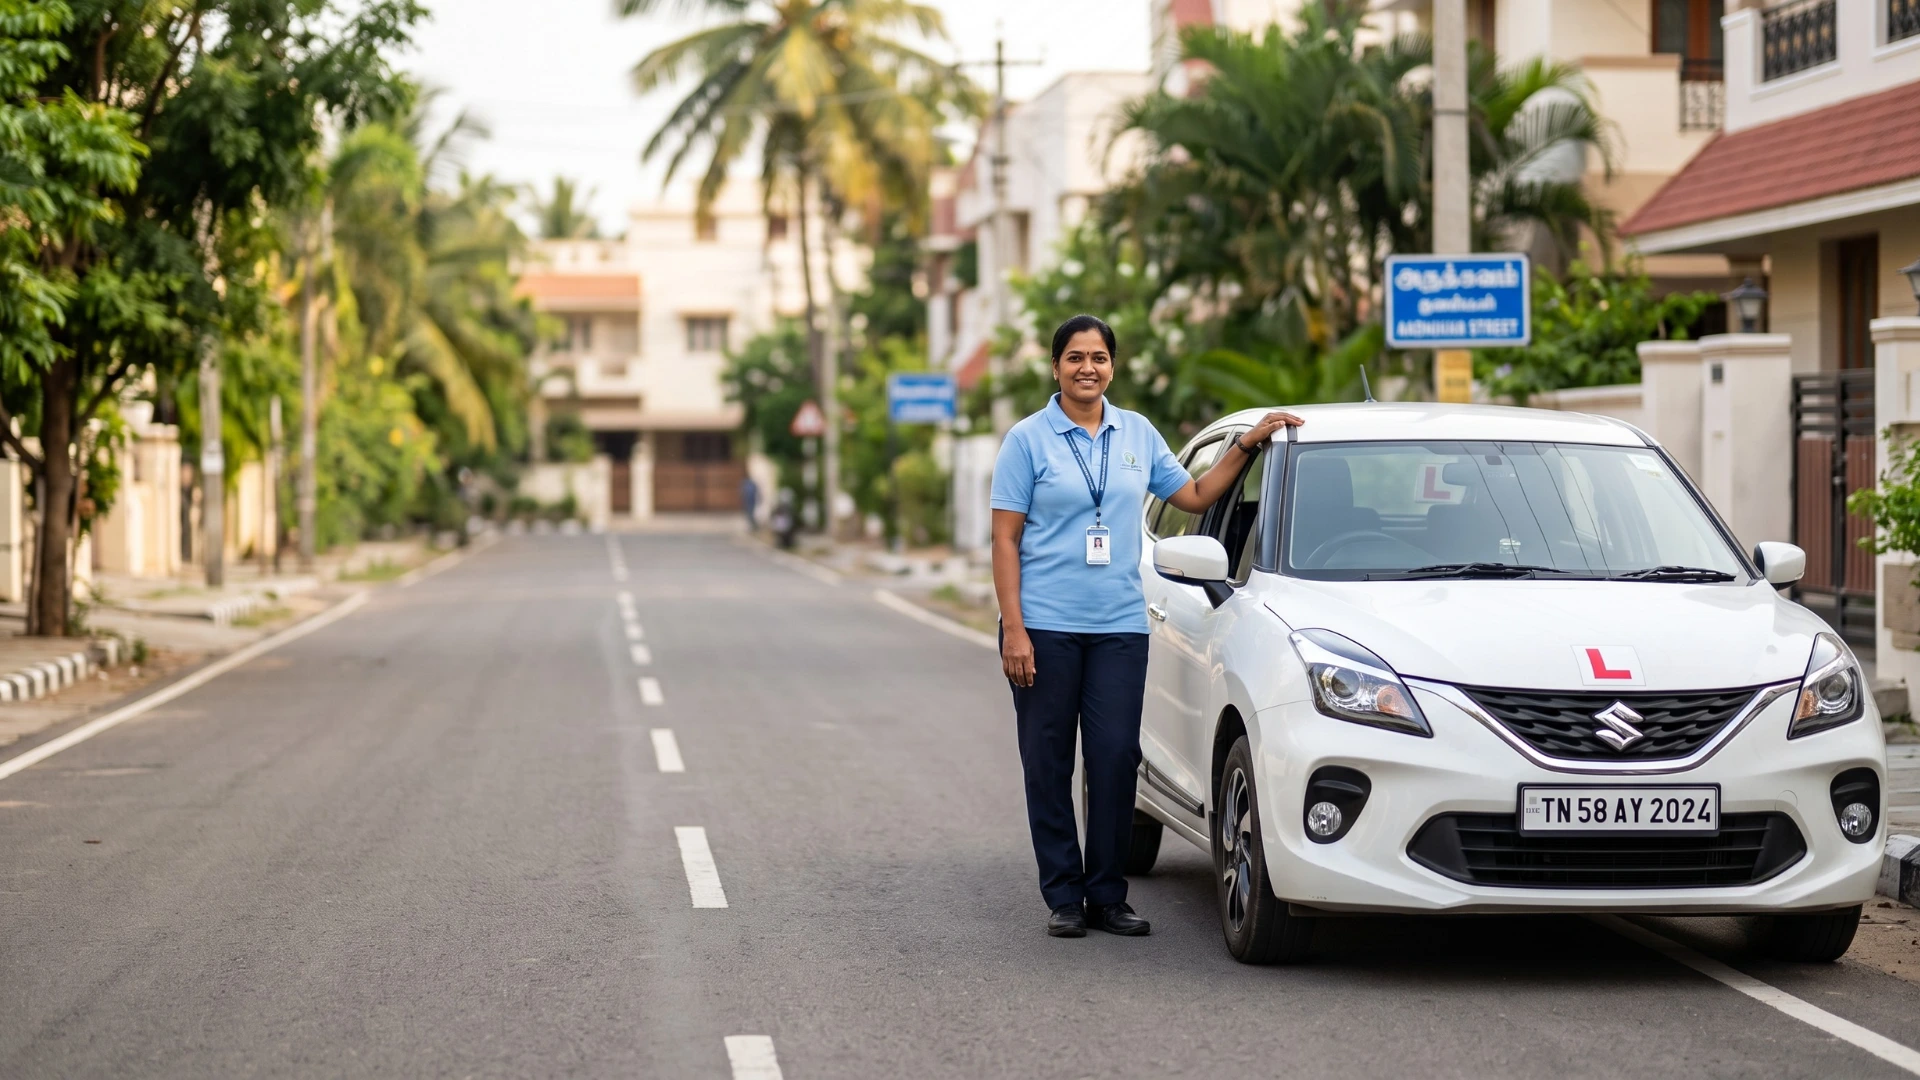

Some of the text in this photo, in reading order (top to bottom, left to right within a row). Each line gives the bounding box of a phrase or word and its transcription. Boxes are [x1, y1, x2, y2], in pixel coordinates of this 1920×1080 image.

[1469, 317, 1519, 337] STREET
[1423, 466, 1451, 500] L
[1585, 648, 1632, 679] L
[1541, 797, 1711, 823] TN 58 AY 2024
